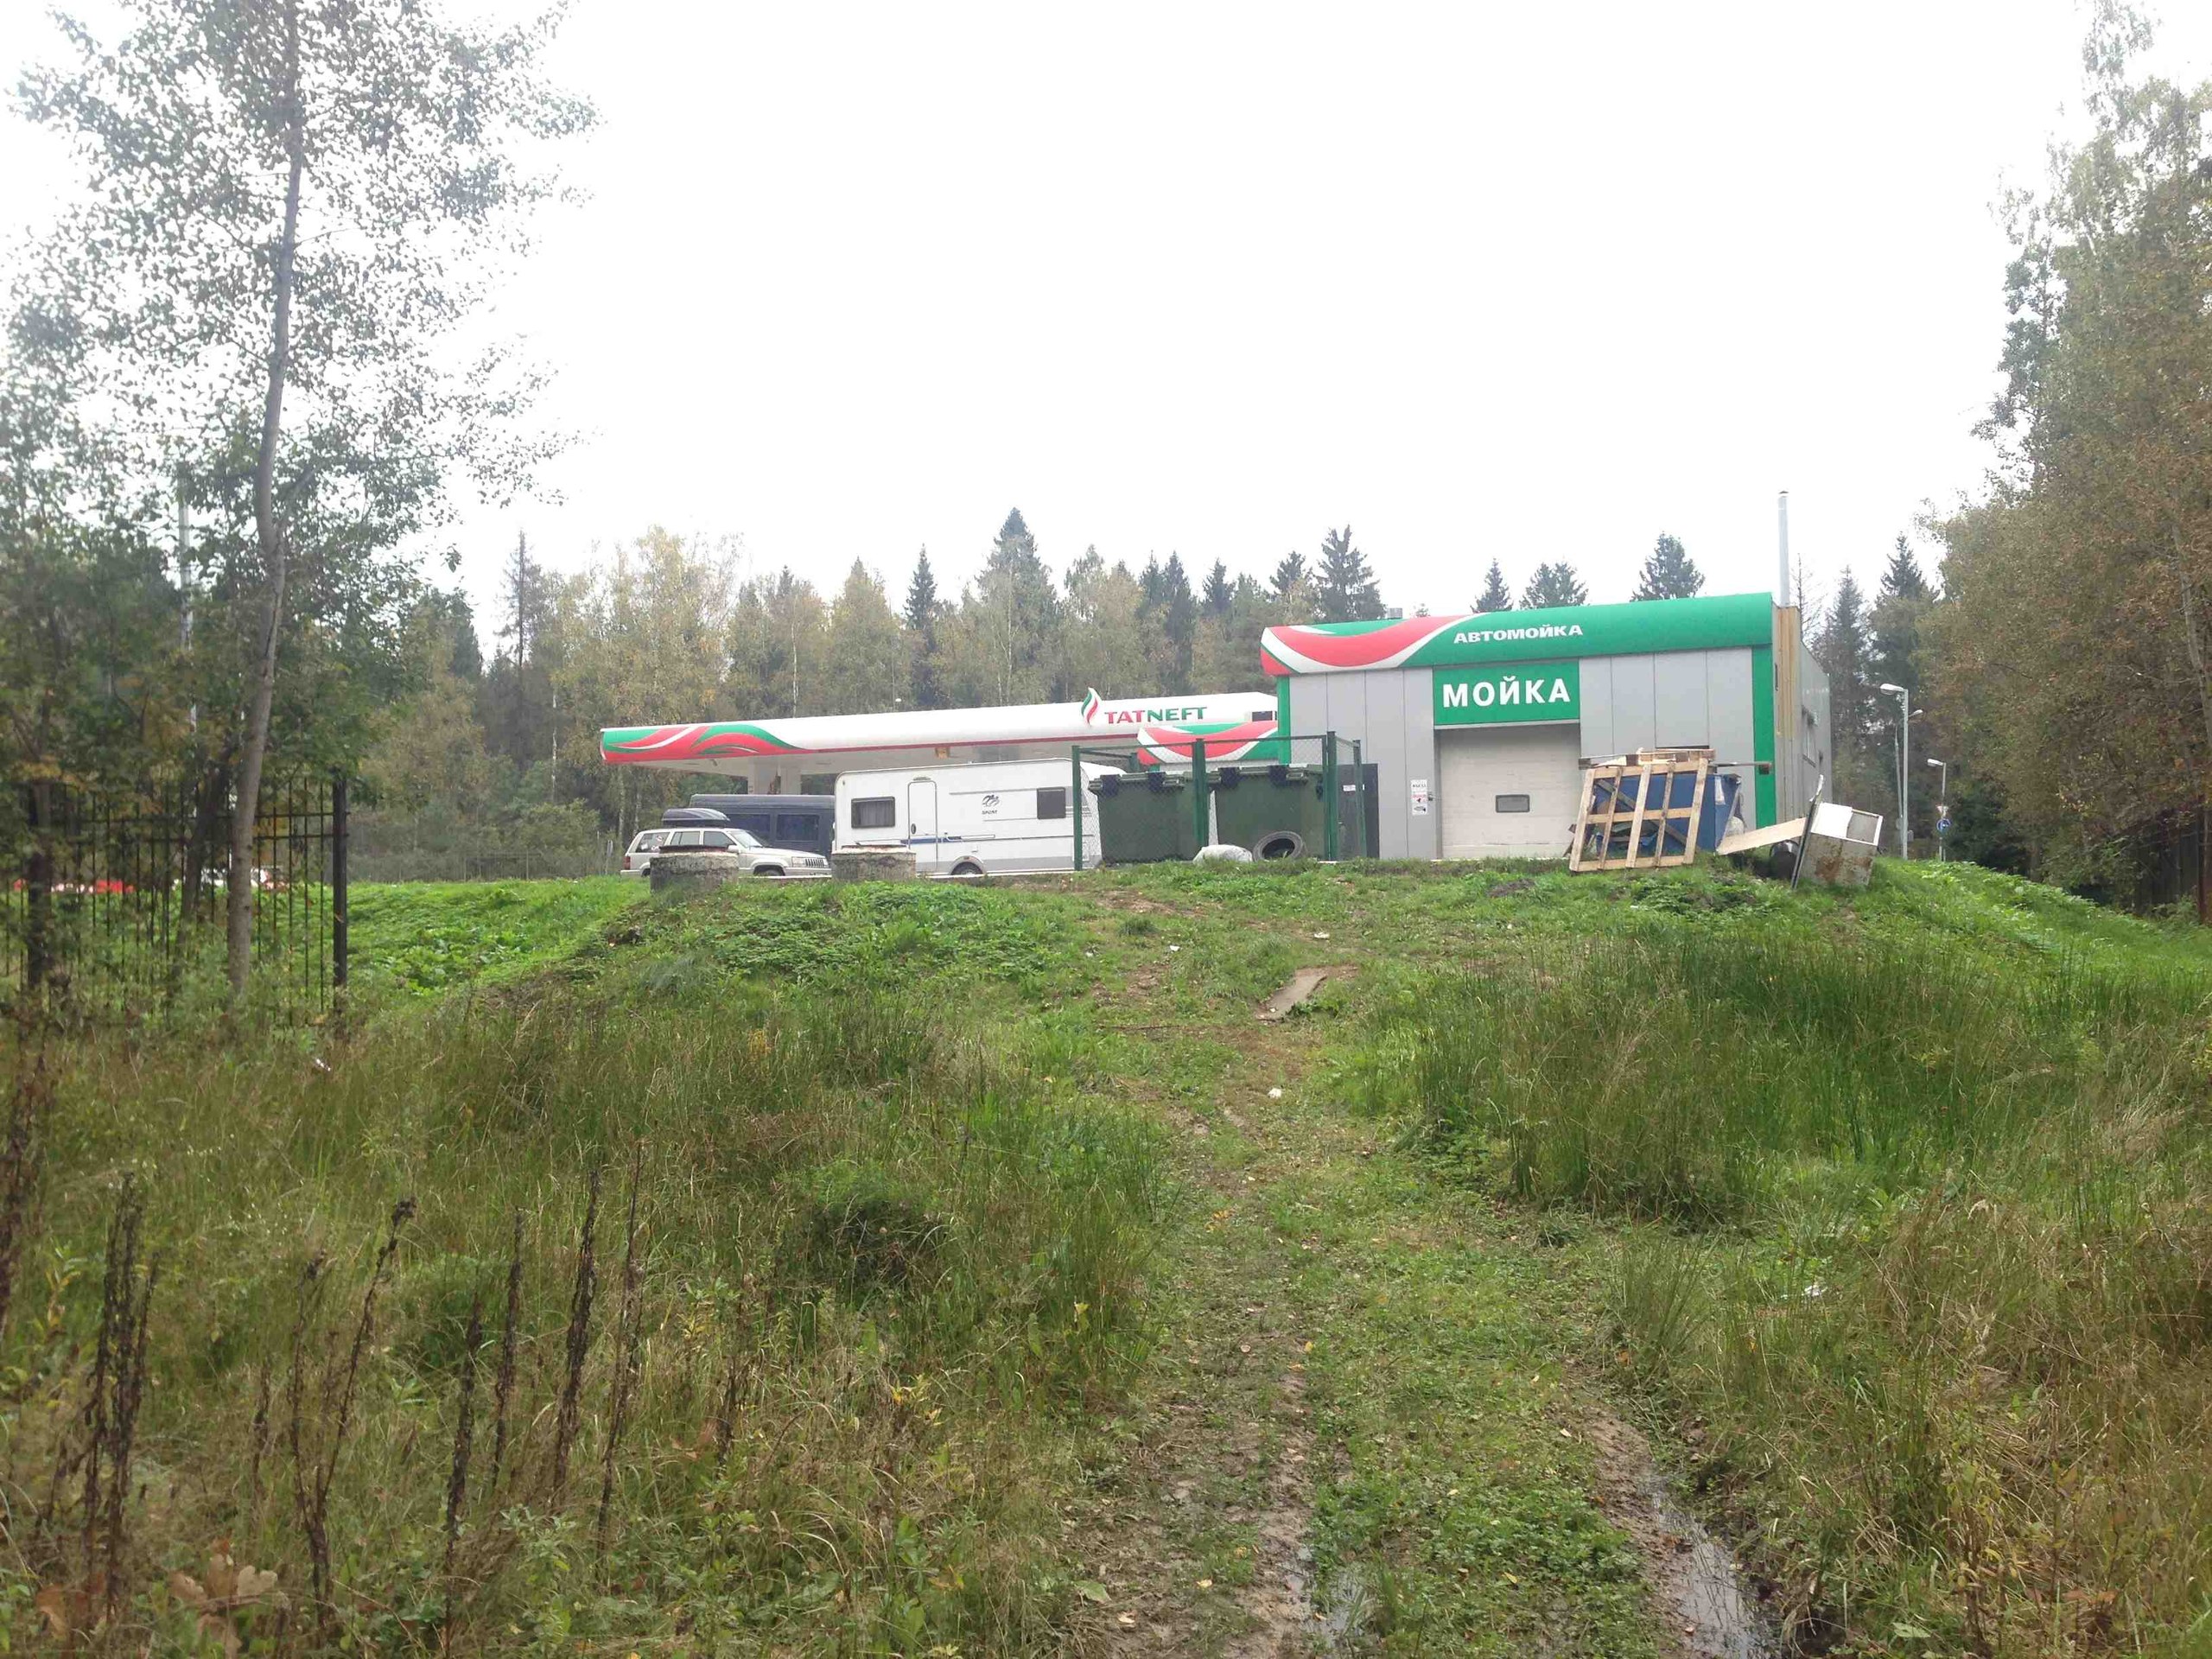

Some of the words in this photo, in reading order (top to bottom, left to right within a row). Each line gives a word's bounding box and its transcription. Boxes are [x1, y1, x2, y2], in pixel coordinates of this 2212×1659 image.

[1453, 624, 1584, 644] АВТОМОЙКА
[1442, 675, 1571, 708] МОЙКА
[1104, 707, 1207, 724] TATNEFT
